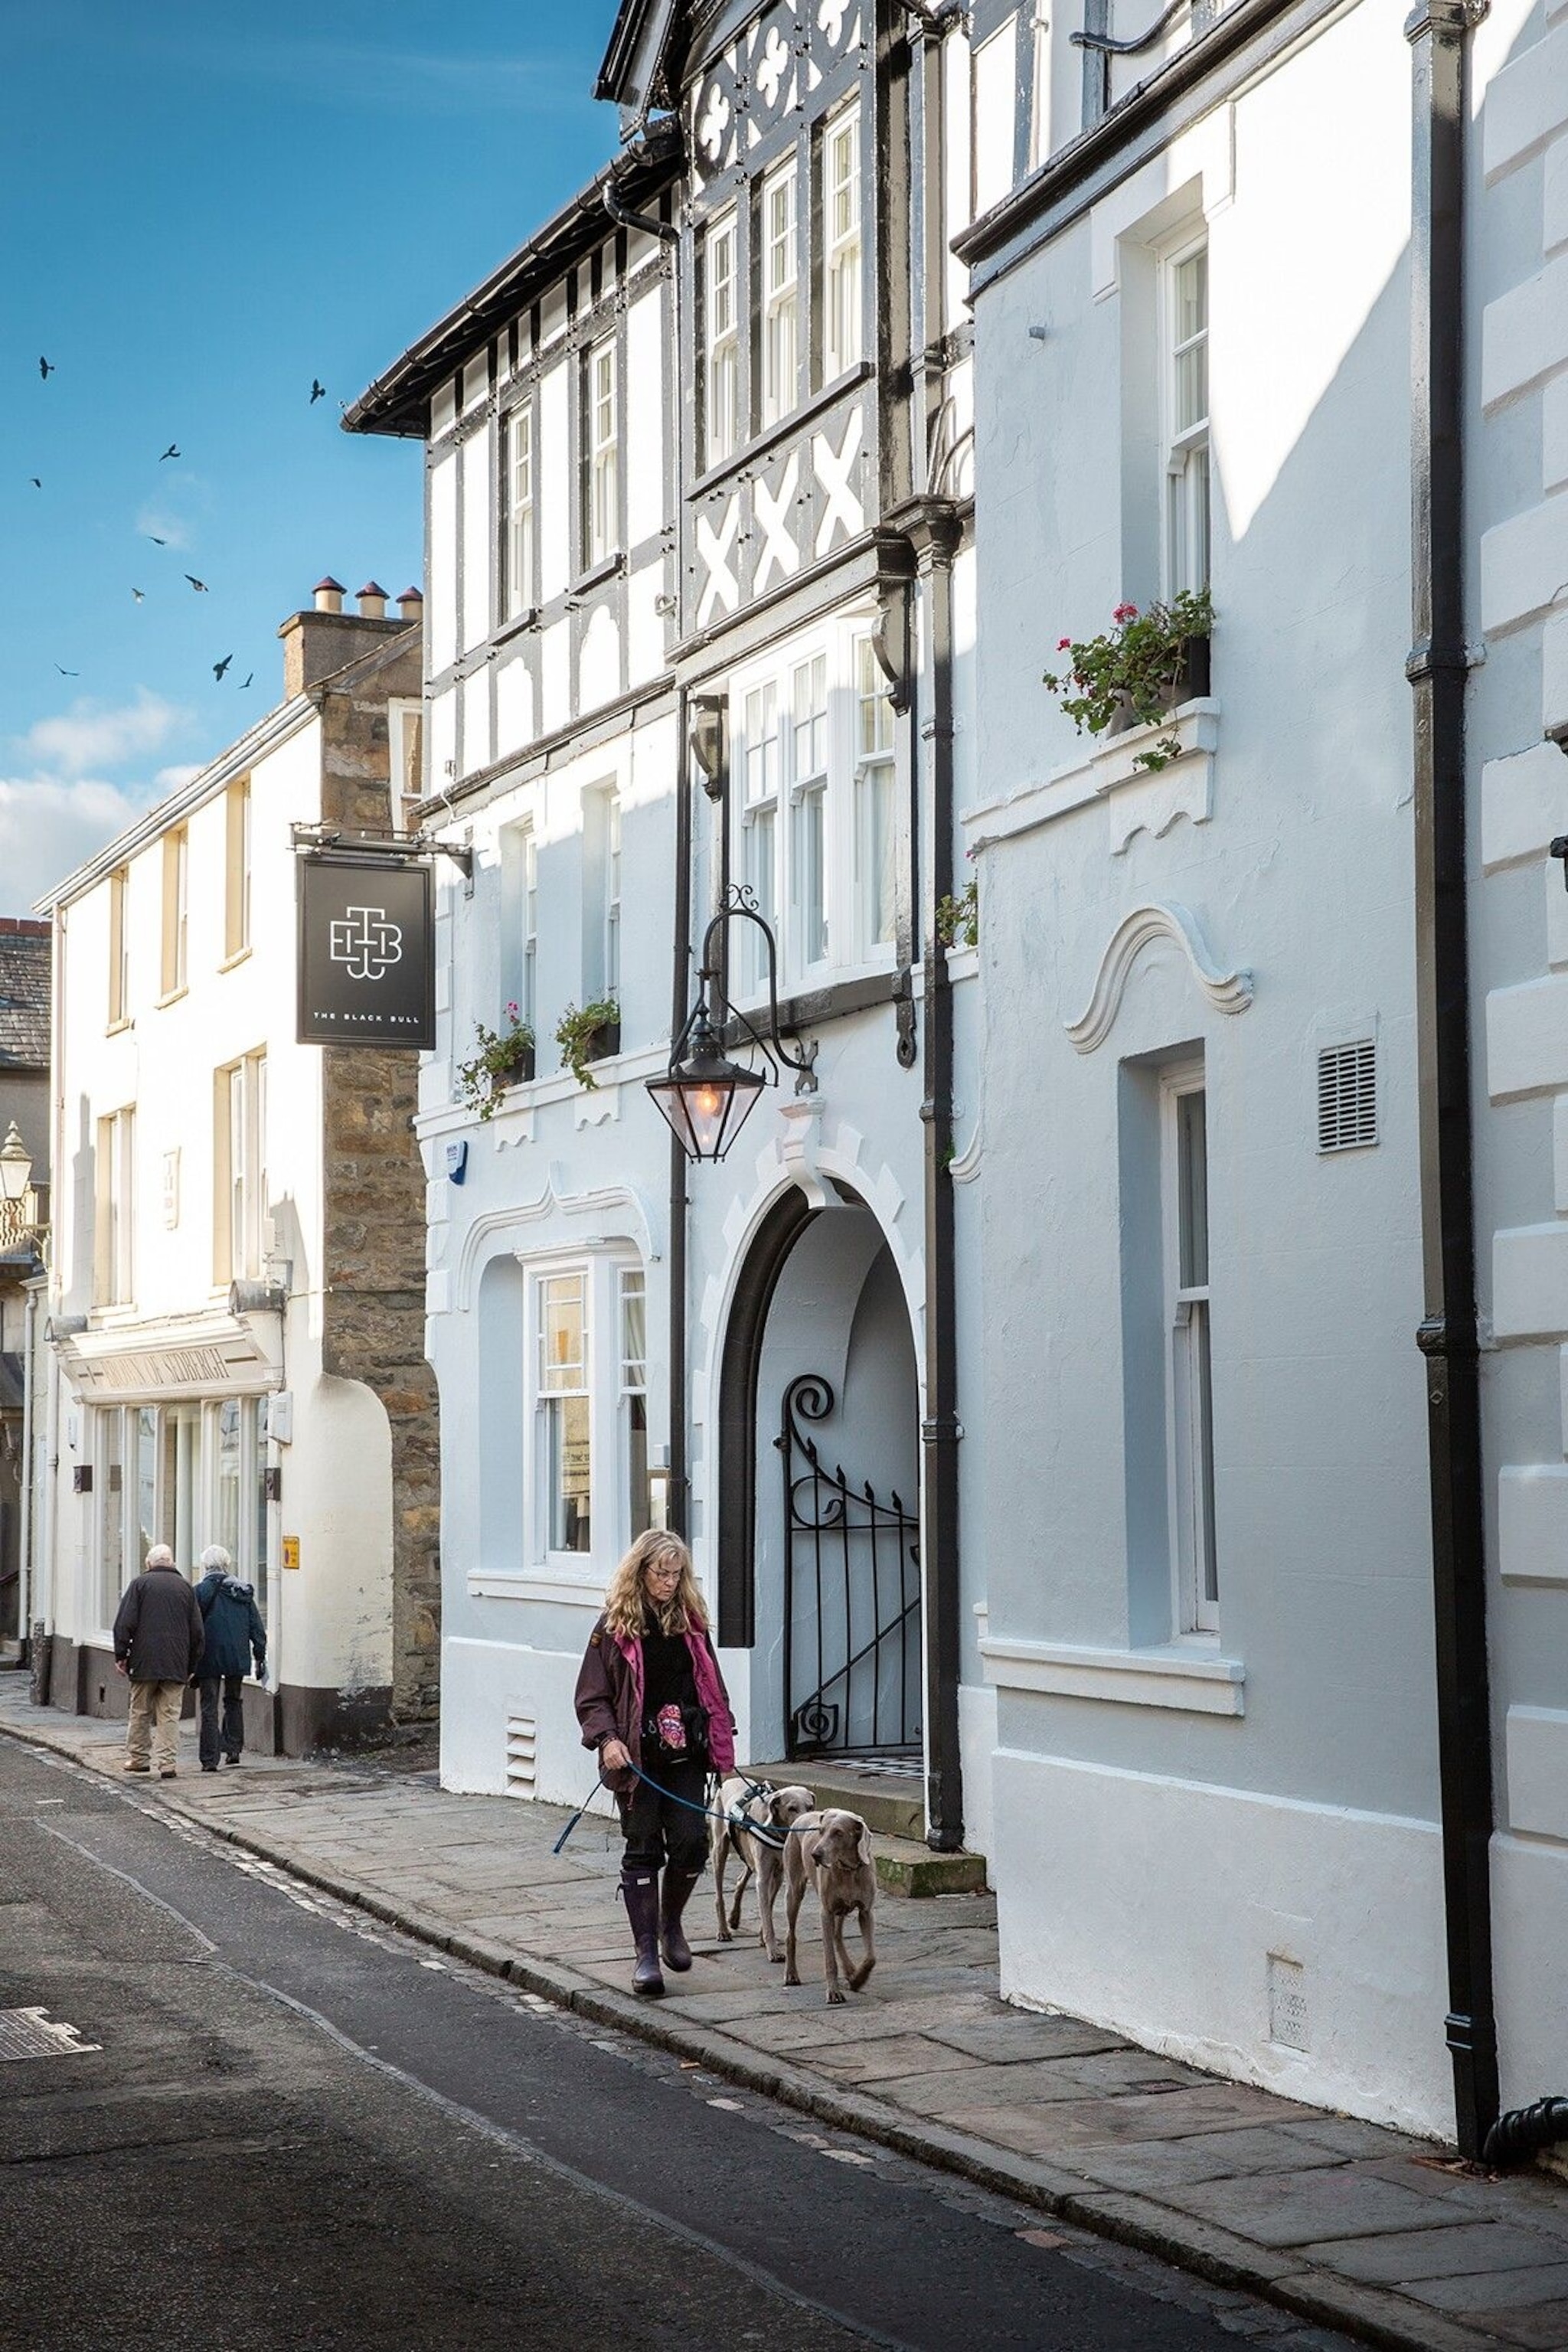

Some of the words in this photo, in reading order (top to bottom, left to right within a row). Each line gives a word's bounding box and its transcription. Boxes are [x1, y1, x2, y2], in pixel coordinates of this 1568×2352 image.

[313, 1011, 336, 1020] THE
[344, 1013, 383, 1022] BLACK
[390, 1015, 420, 1024] BULL
[144, 1354, 165, 1386] OF
[162, 1348, 230, 1383] SEDBERGH
